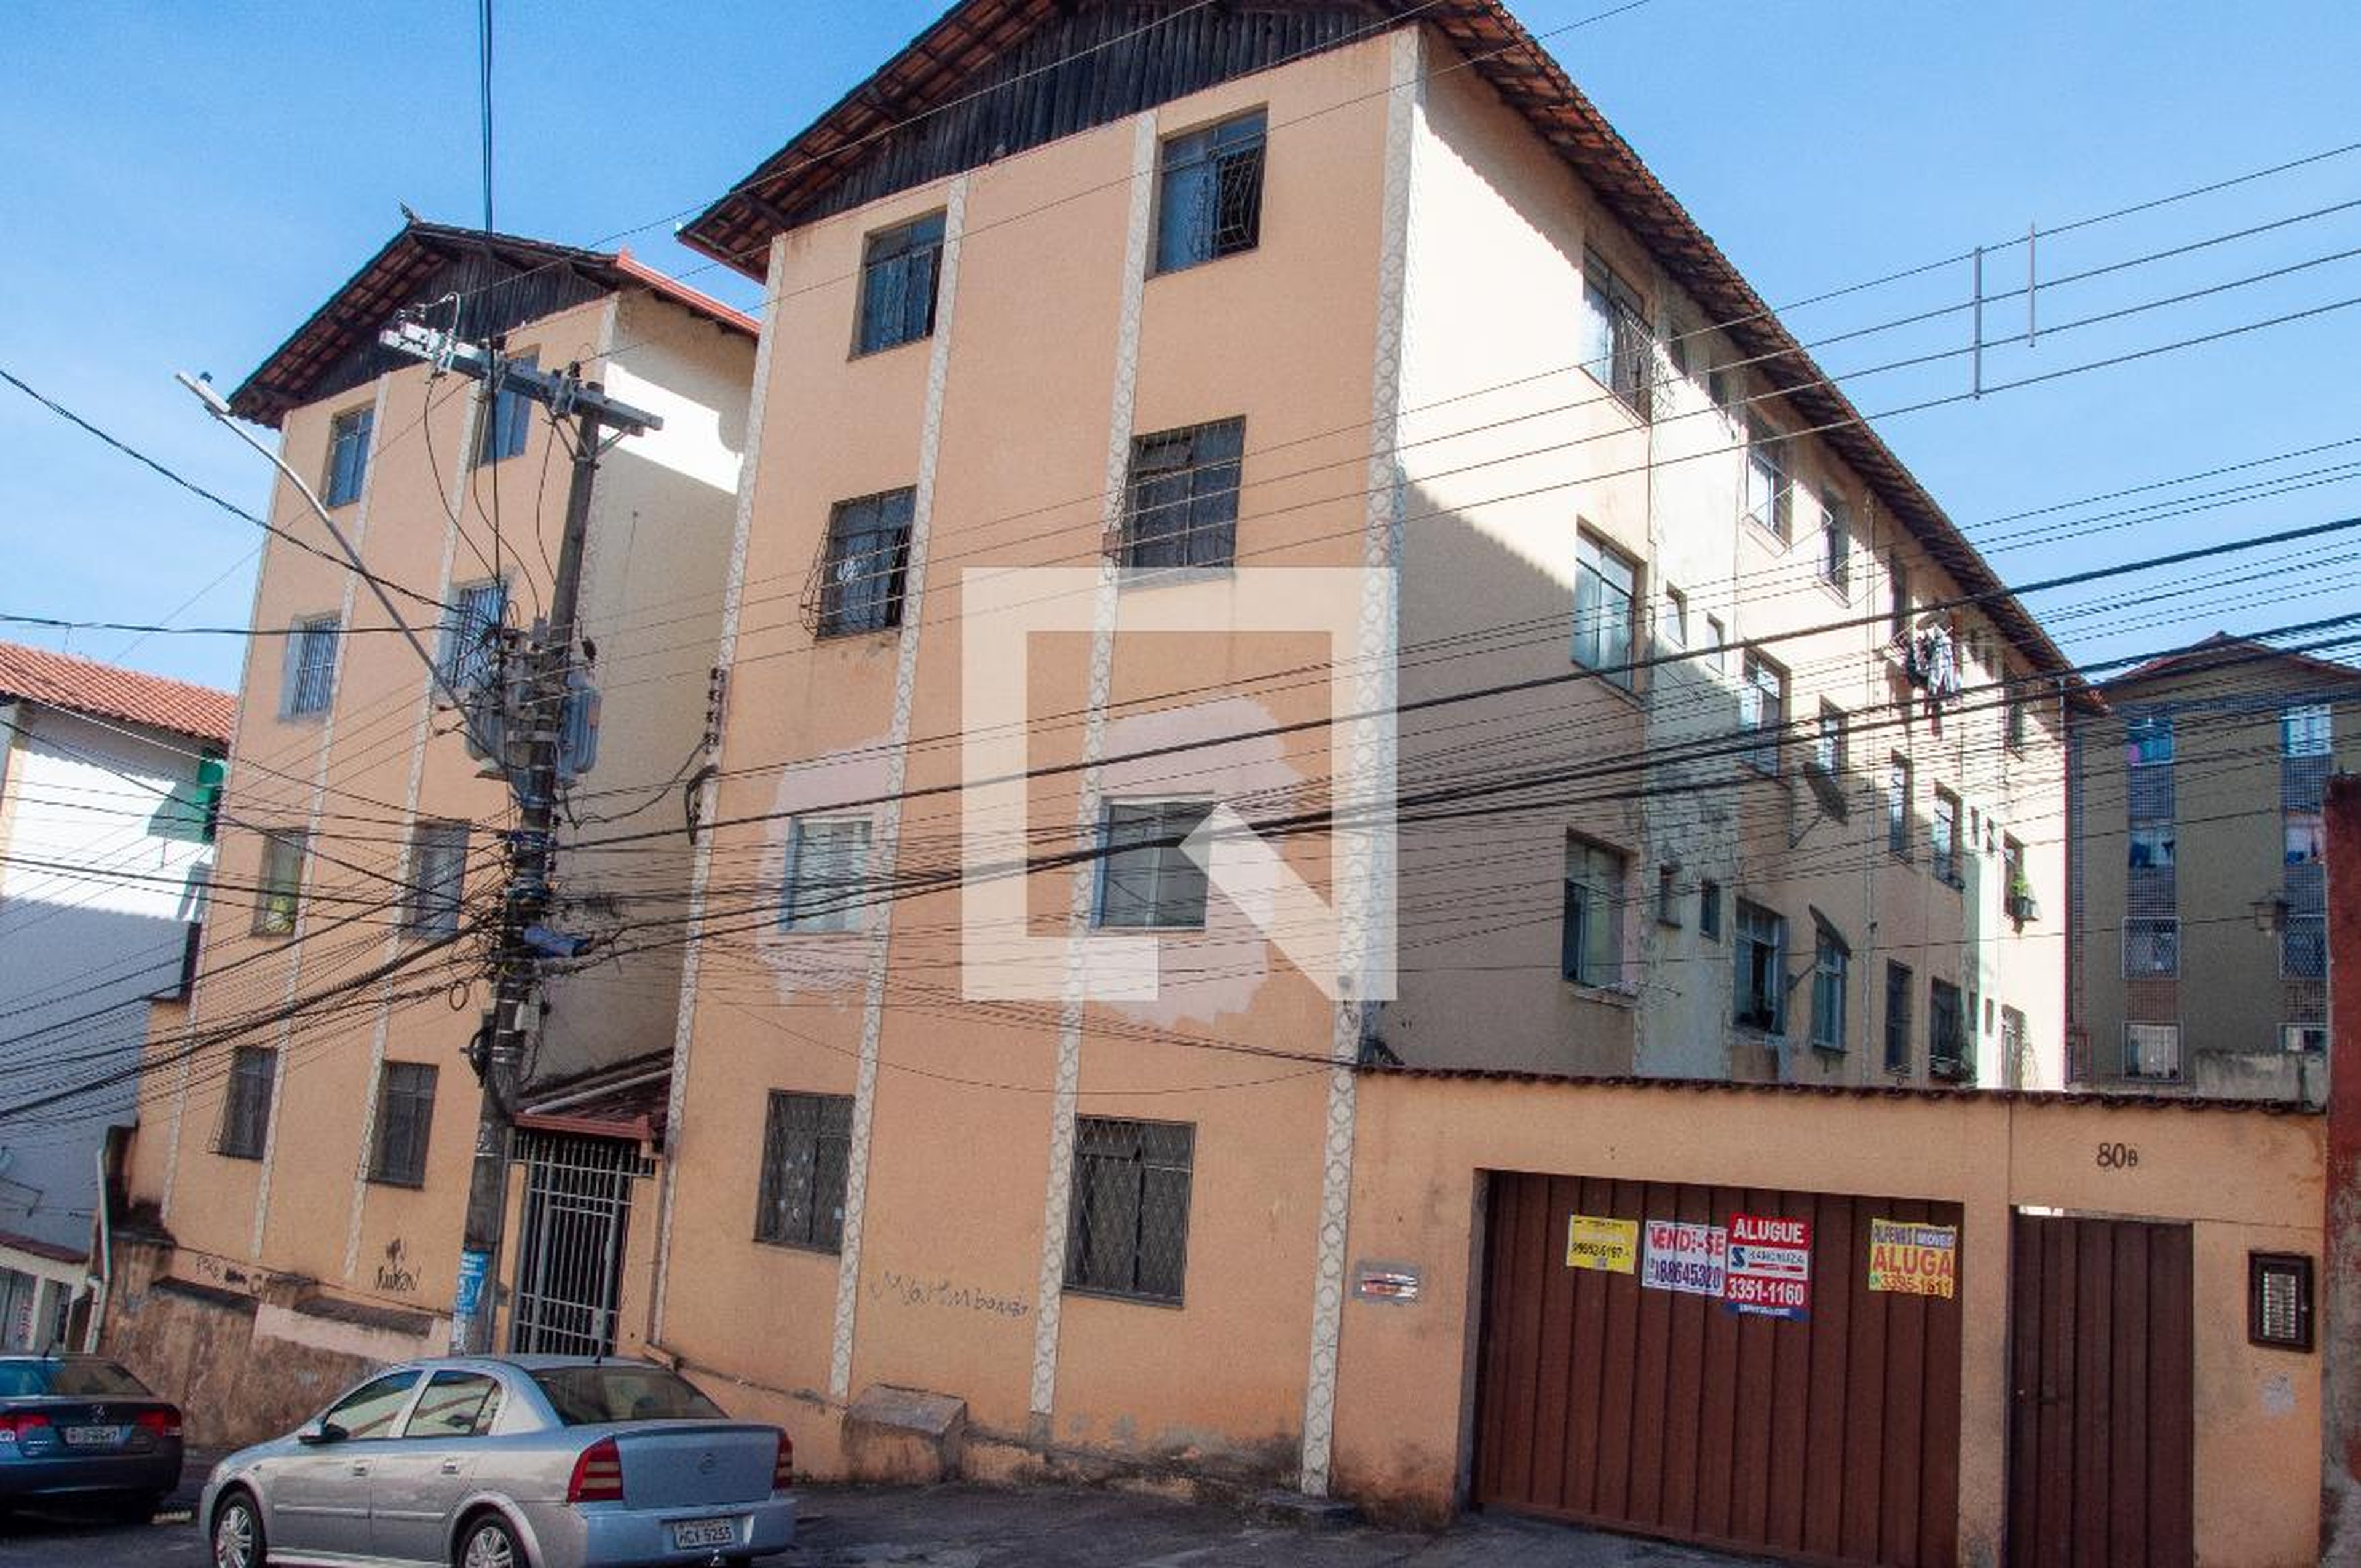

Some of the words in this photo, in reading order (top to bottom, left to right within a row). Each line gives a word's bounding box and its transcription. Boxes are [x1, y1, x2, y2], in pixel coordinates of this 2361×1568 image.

[2097, 1142, 2138, 1169] 80B
[1733, 1218, 1805, 1245] ALUGUE
[1873, 1245, 1953, 1278] ALUGA
[1728, 1276, 1804, 1306] 3351-1160
